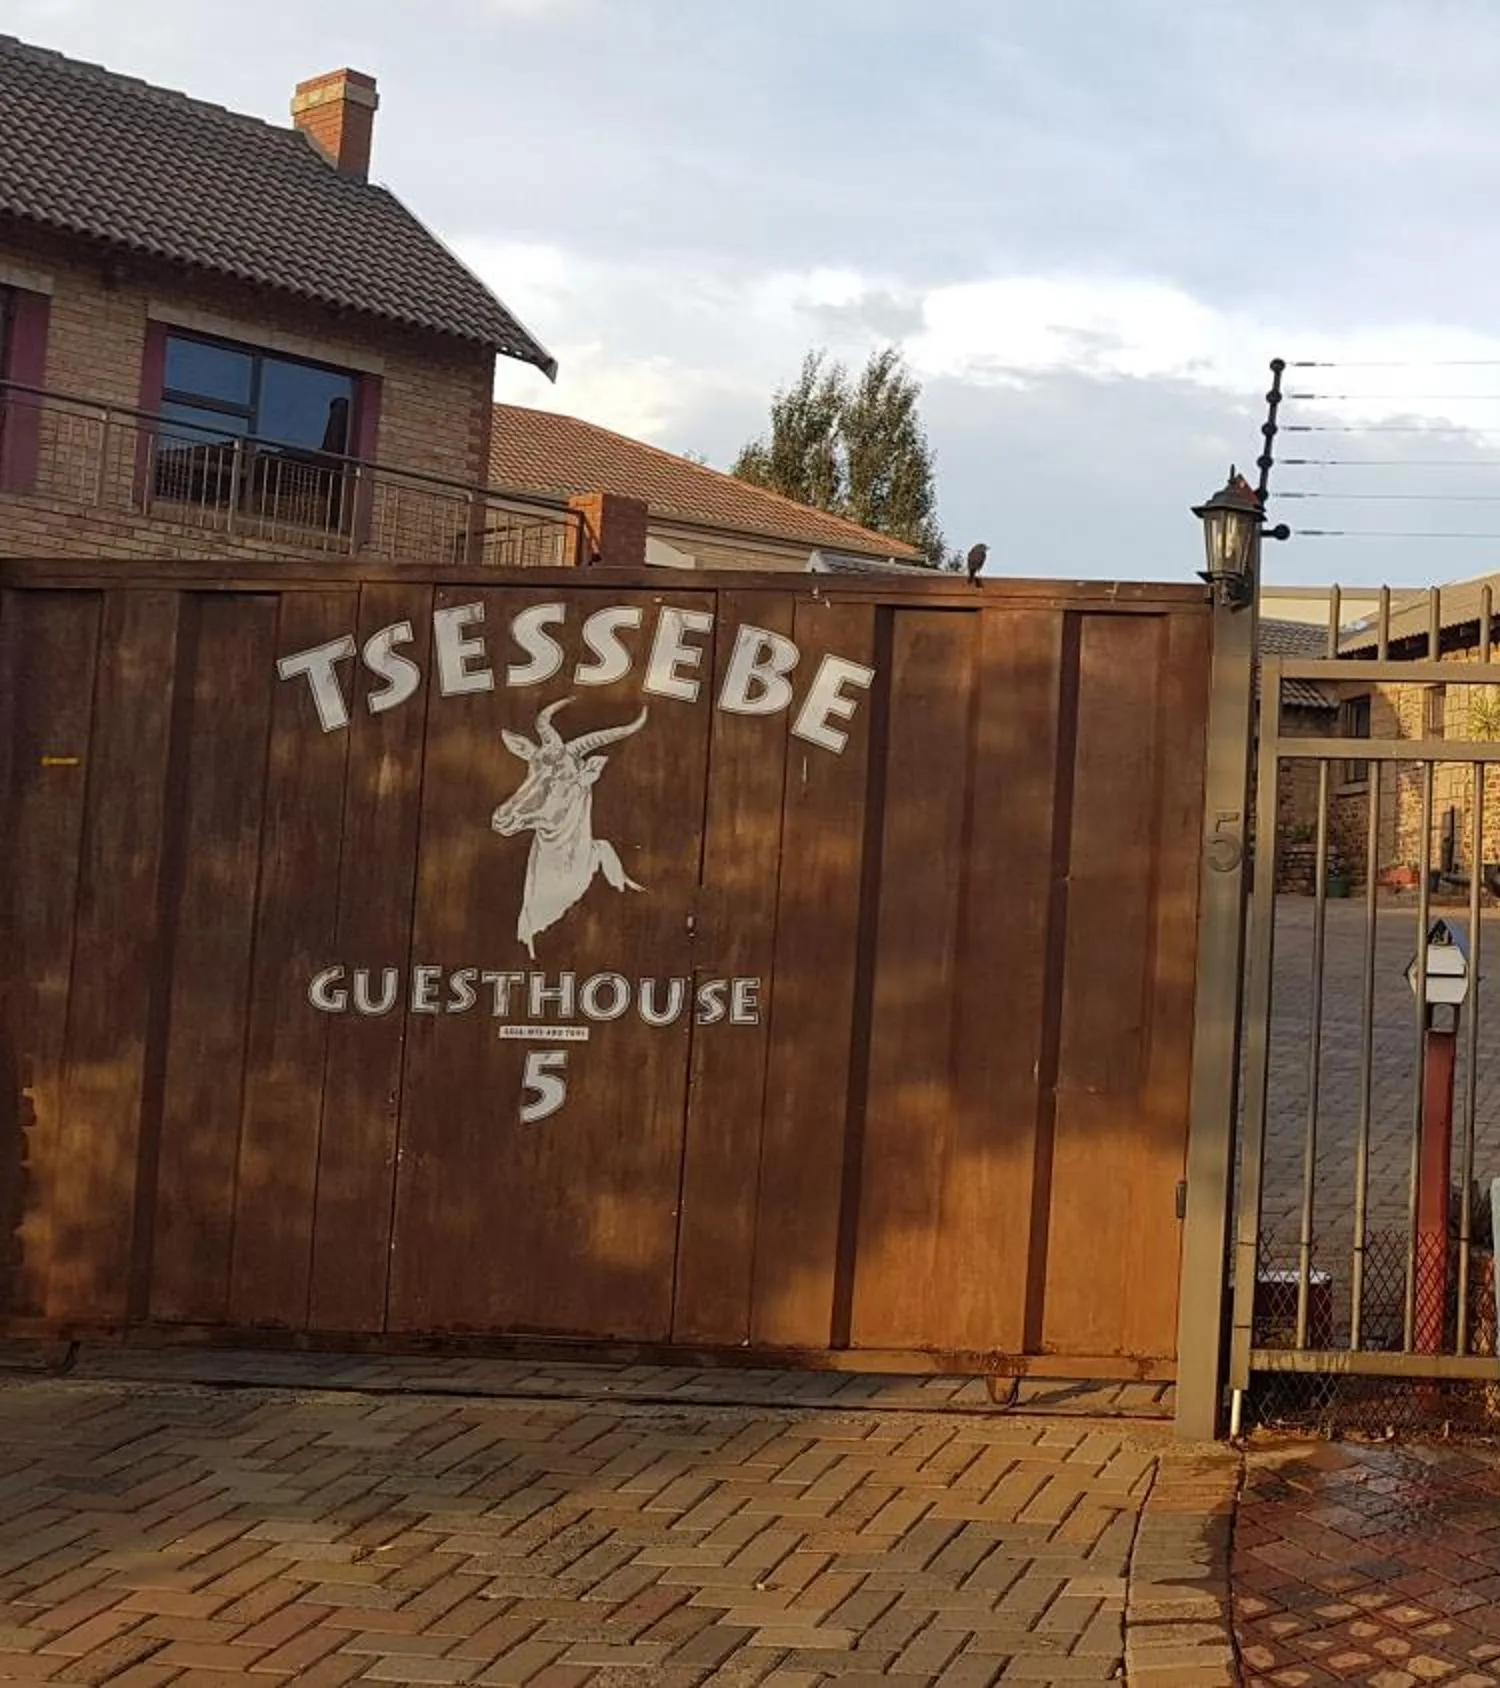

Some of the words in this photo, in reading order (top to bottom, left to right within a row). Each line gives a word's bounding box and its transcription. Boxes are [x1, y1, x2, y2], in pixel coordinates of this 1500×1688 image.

[276, 601, 876, 754] TSESSEBE
[307, 965, 760, 1026] GUESTHOUSE
[518, 1049, 568, 1124] 5
